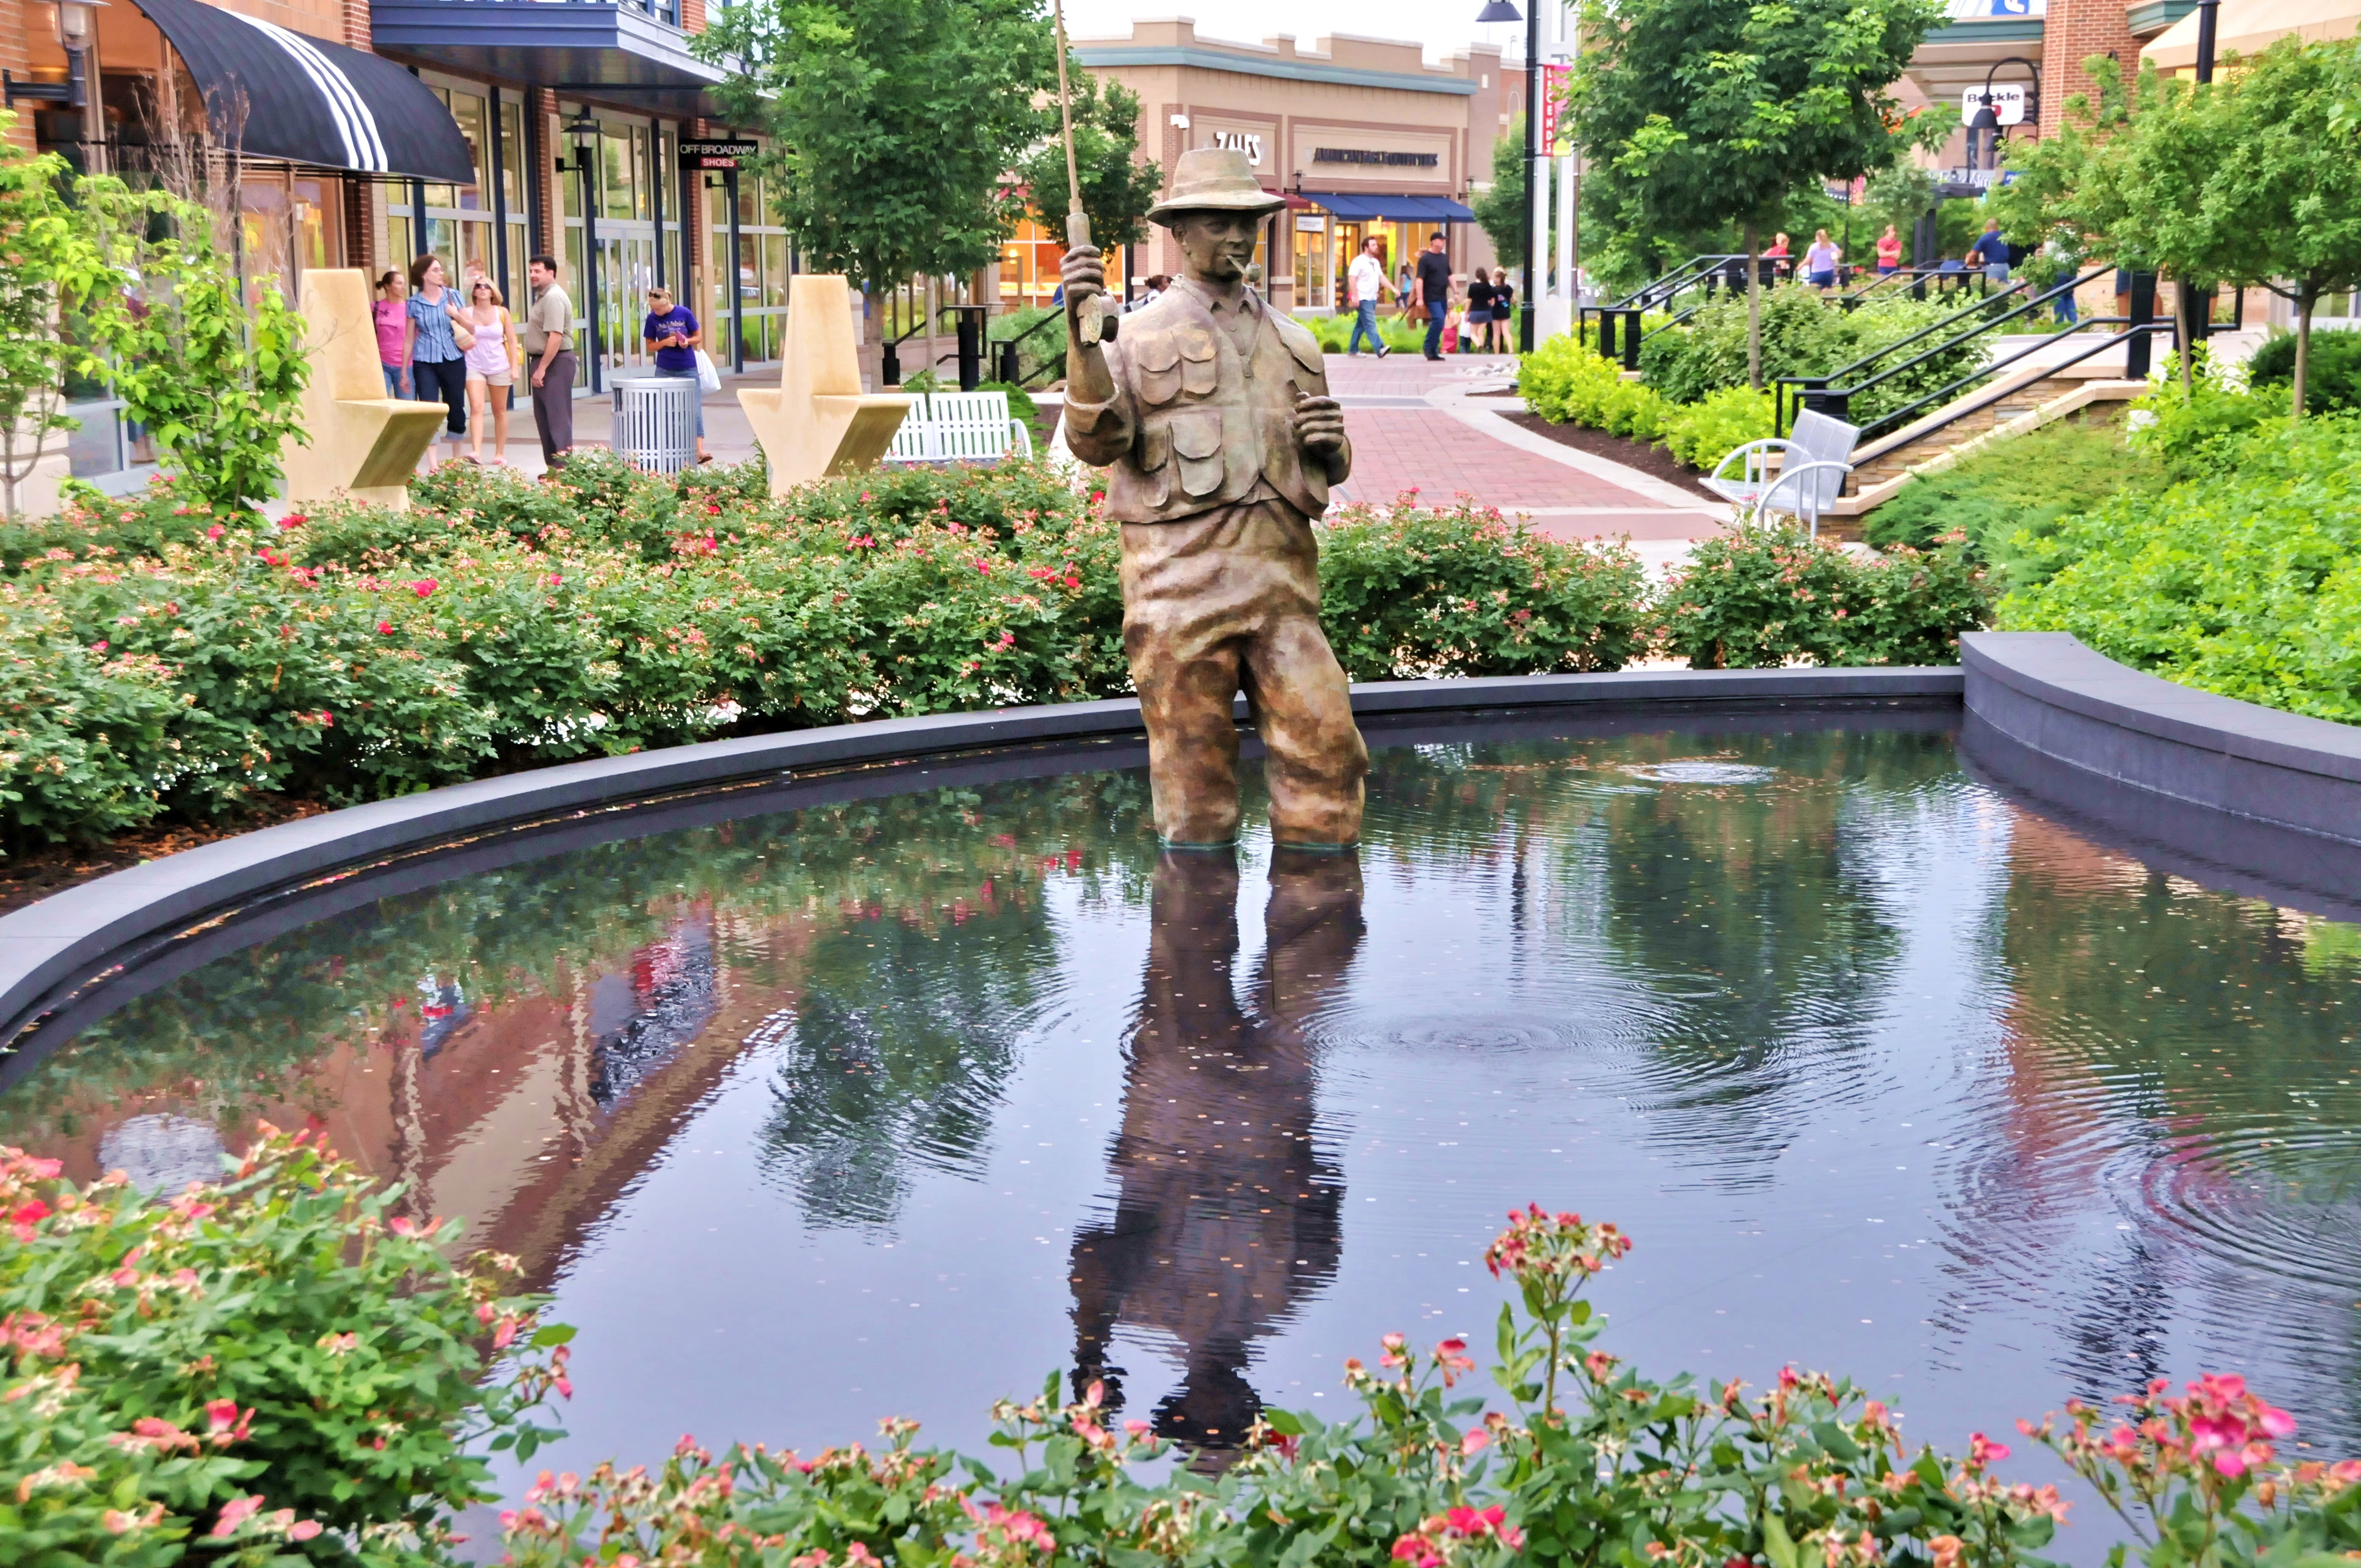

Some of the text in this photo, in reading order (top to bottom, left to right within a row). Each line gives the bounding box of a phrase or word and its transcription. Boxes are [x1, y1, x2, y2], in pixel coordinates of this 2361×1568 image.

[1967, 92, 2020, 103] Bkle
[679, 144, 757, 155] OFF BROADWAY
[703, 158, 735, 167] SHOES
